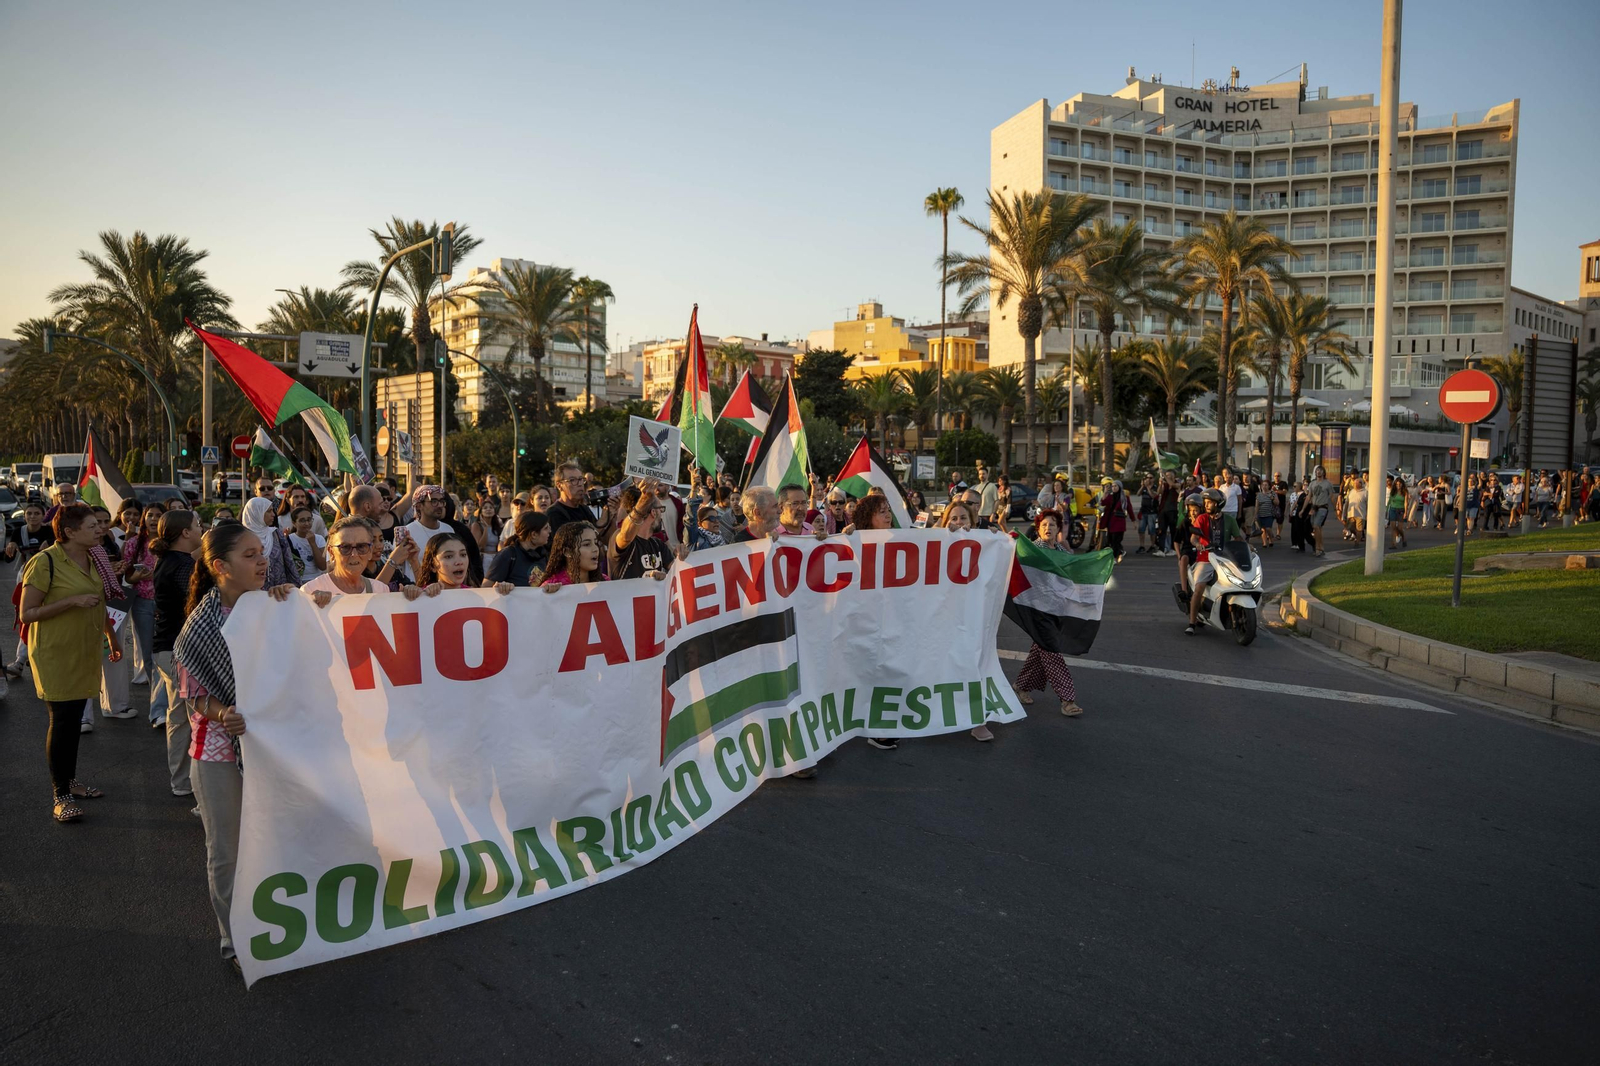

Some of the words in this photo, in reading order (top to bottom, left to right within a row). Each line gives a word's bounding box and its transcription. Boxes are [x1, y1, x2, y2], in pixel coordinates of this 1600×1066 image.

[1175, 96, 1213, 113] GRAN
[1225, 98, 1280, 114] HOTEL
[1193, 118, 1262, 133] ALMERIA
[629, 465, 637, 473] NO
[646, 469, 673, 481] GENOCIDIO
[342, 606, 509, 691] NO
[557, 595, 666, 673] AL
[666, 539, 982, 640] GENOCIDIO
[250, 760, 713, 962] SOLIDARIDAD
[714, 710, 808, 793] CON
[800, 676, 1014, 752] PALESTIA
